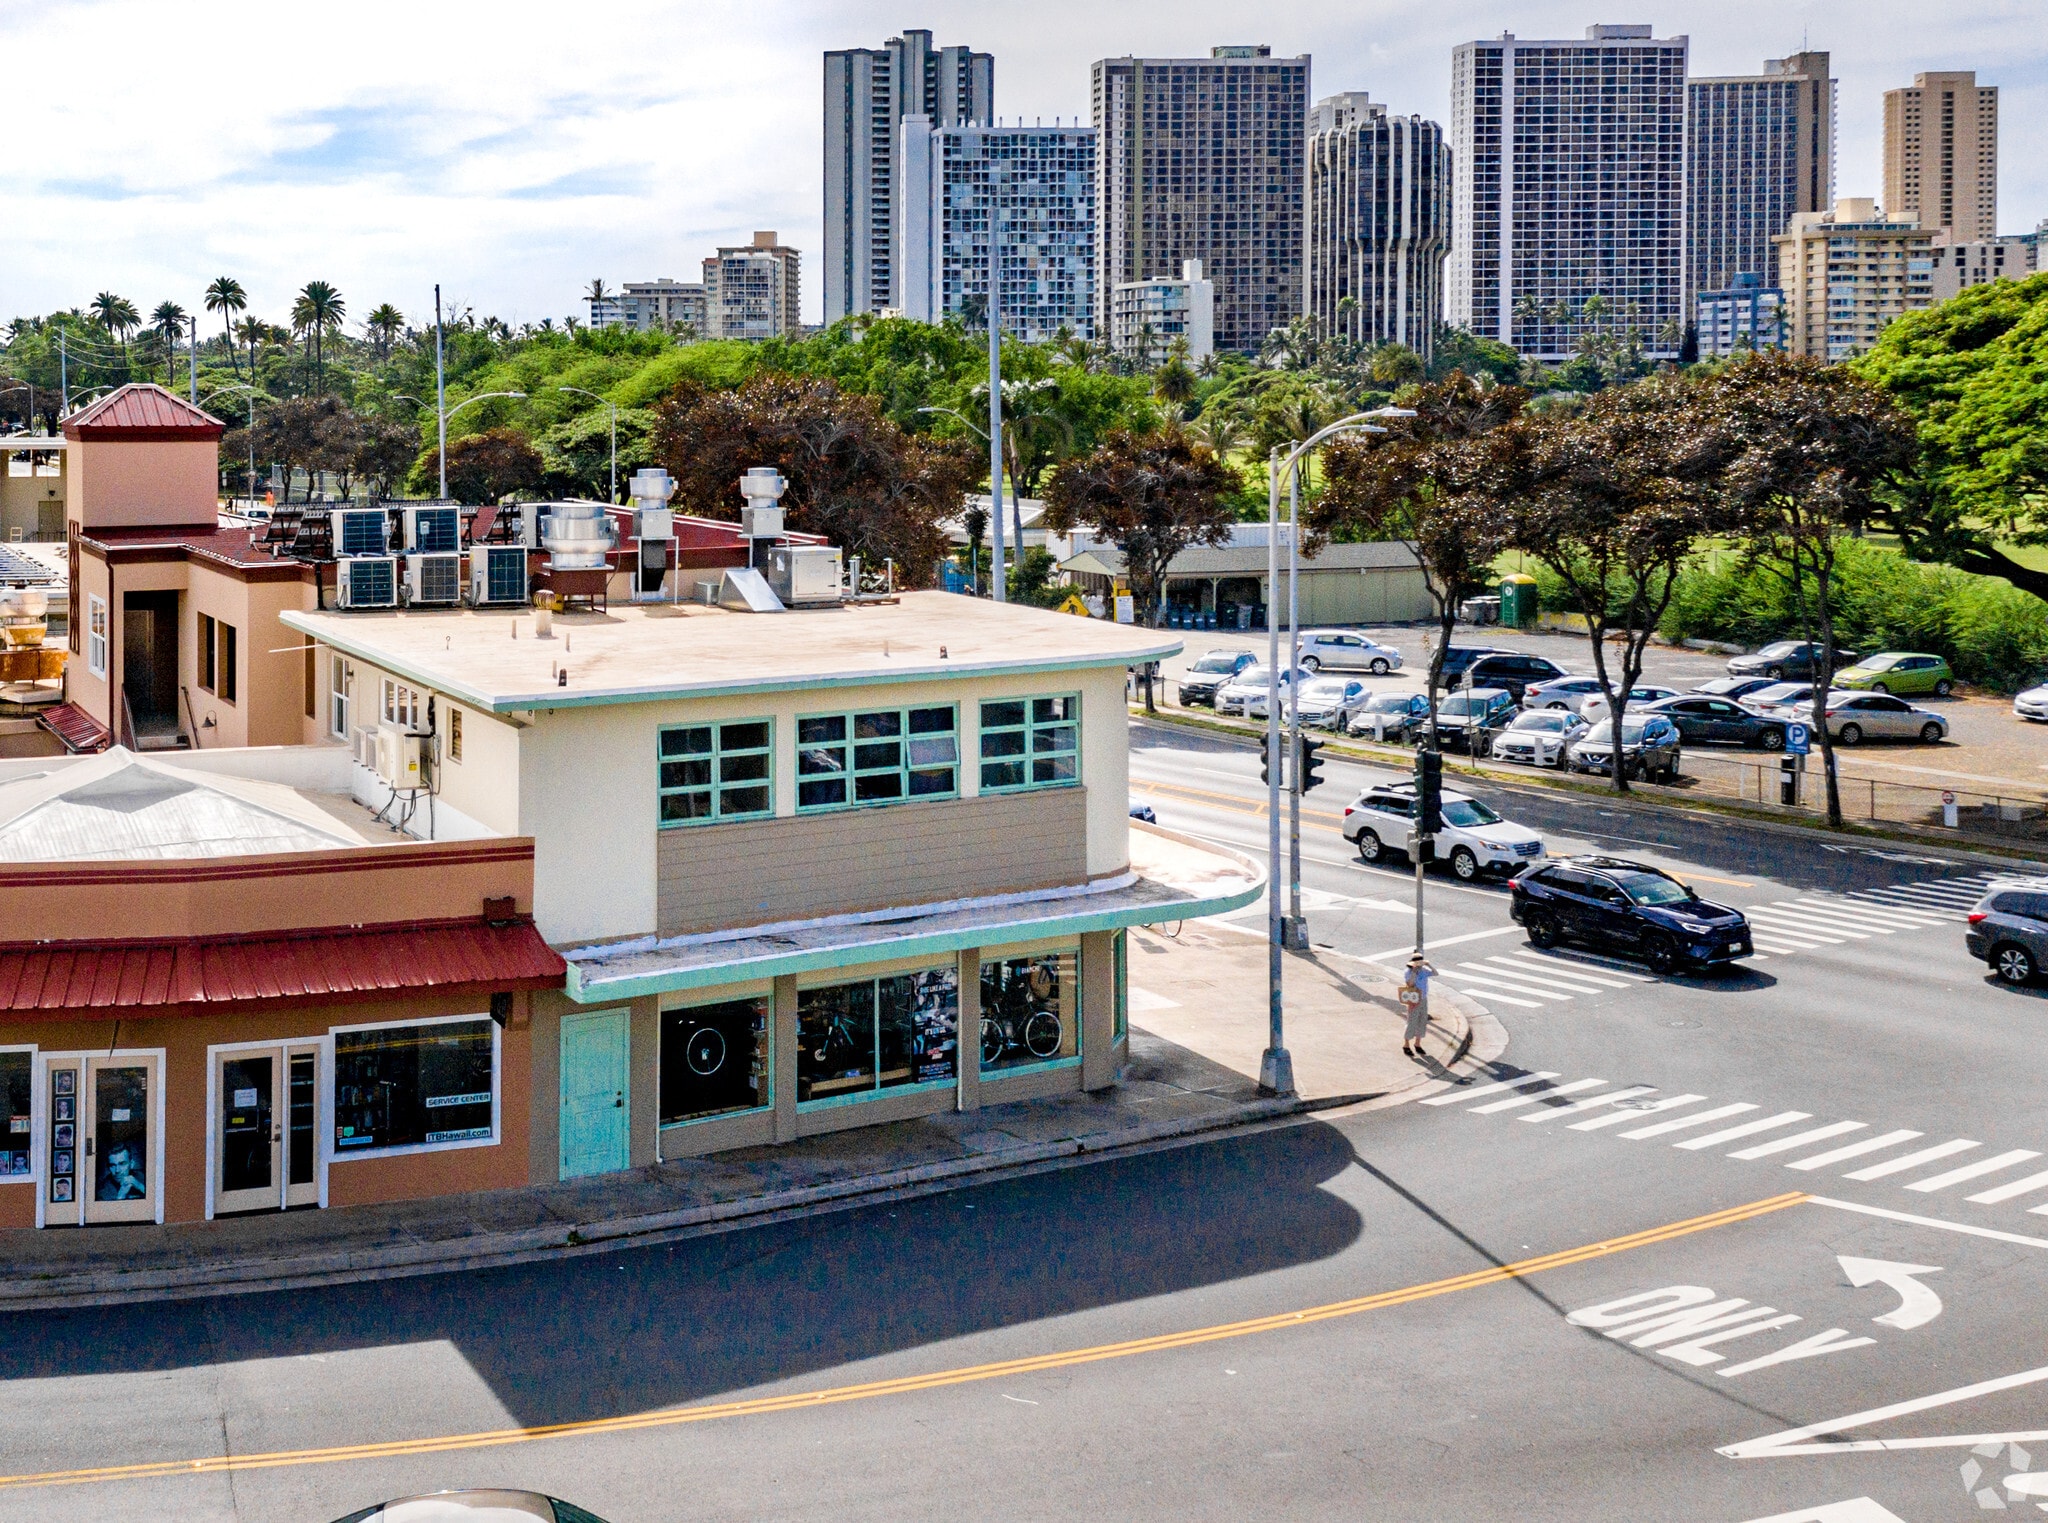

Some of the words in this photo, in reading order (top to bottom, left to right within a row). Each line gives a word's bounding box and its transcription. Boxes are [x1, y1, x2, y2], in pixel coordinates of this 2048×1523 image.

[428, 1096, 459, 1106] SERVICE
[461, 1094, 489, 1103] CENTER
[1566, 1285, 1877, 1377] ONLY
